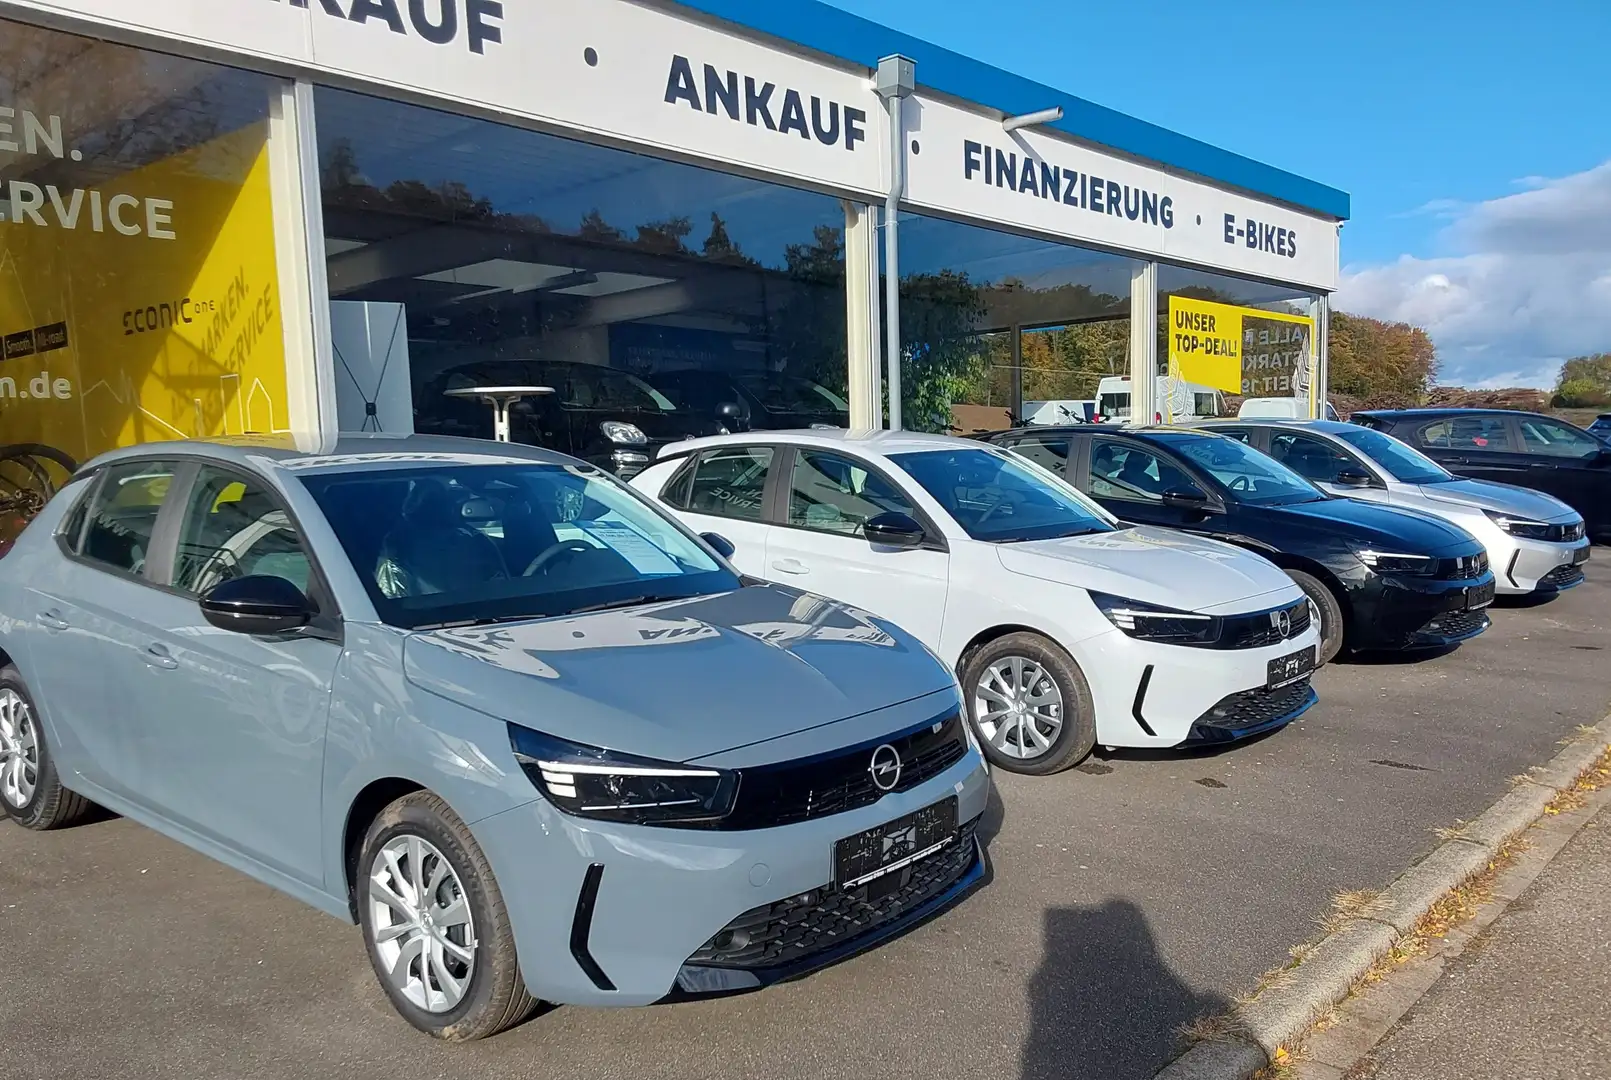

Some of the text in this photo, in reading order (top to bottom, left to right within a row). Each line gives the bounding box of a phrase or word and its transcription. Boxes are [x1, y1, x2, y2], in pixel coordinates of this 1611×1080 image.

[663, 55, 867, 152] ANKAUF
[963, 139, 1175, 230] FINANZIERUNG
[1224, 213, 1298, 259] E-BIKES
[0, 179, 177, 240] RVICE
[1175, 309, 1217, 333] UNSER
[1175, 333, 1237, 358] TOP-DEAL!
